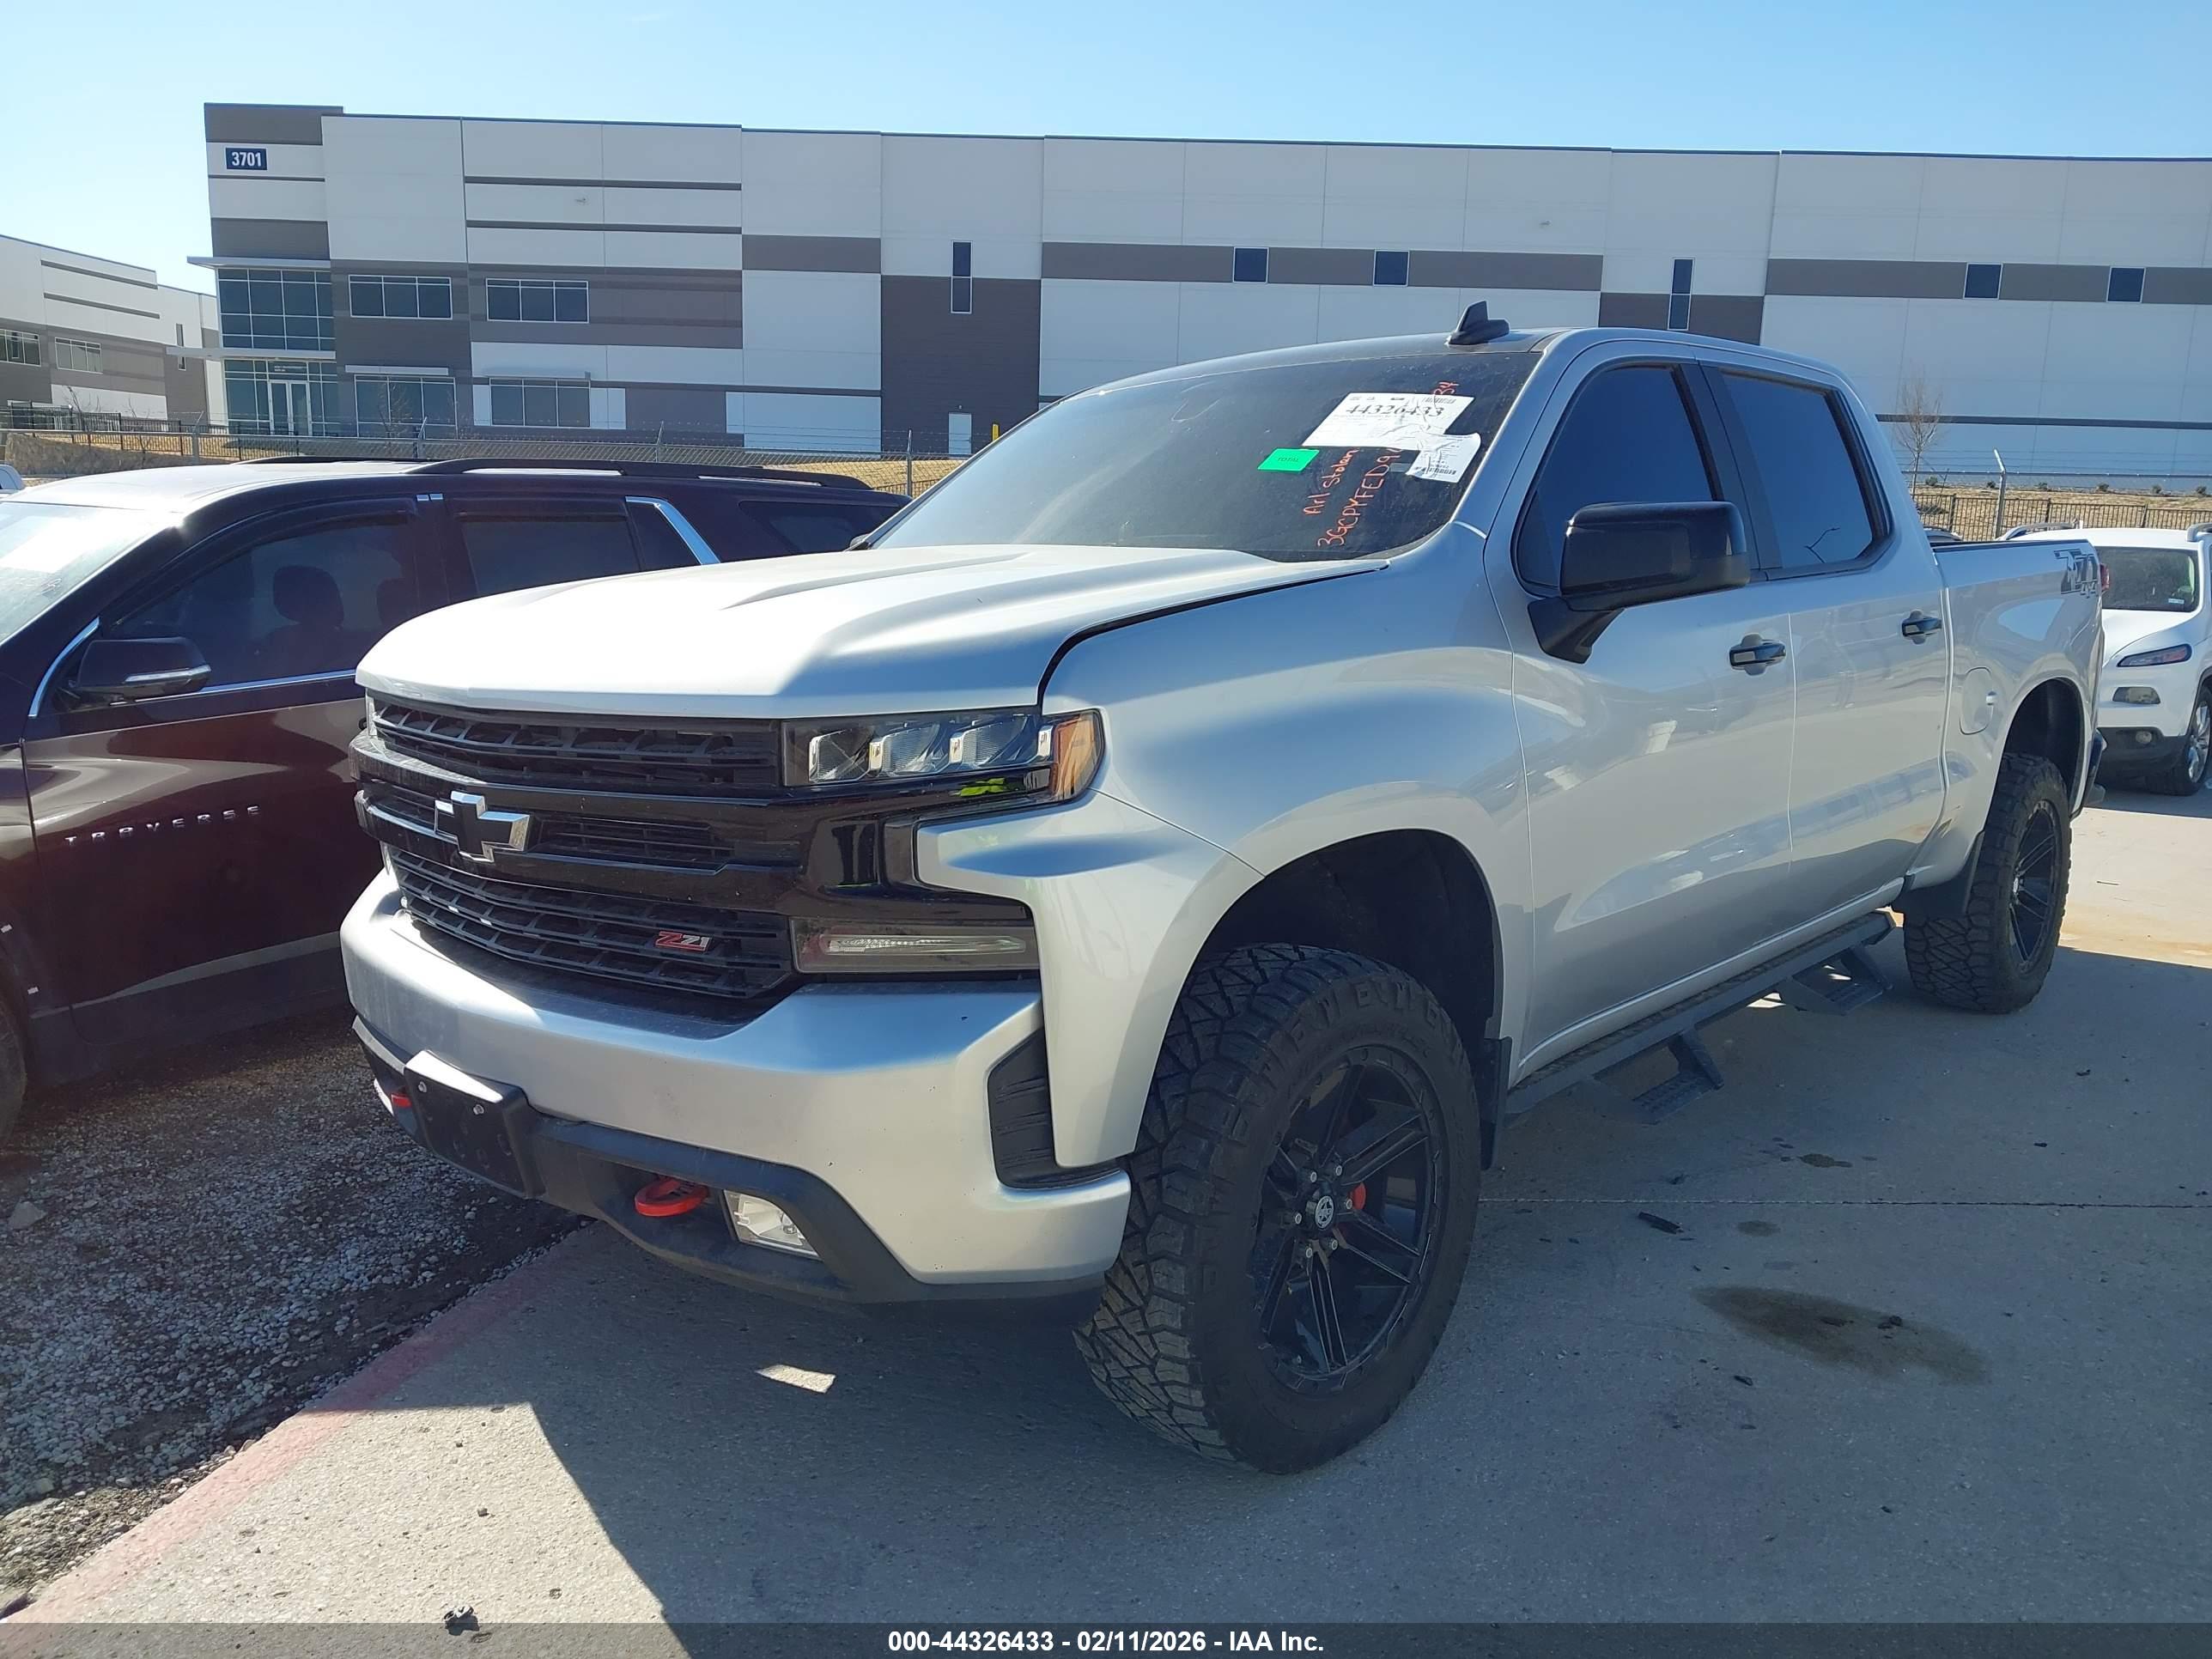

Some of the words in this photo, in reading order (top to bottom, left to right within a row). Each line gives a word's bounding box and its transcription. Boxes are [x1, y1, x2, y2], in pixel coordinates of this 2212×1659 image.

[231, 151, 262, 167] 3701
[64, 805, 260, 846] TRAVERSE
[654, 930, 713, 952] Z71
